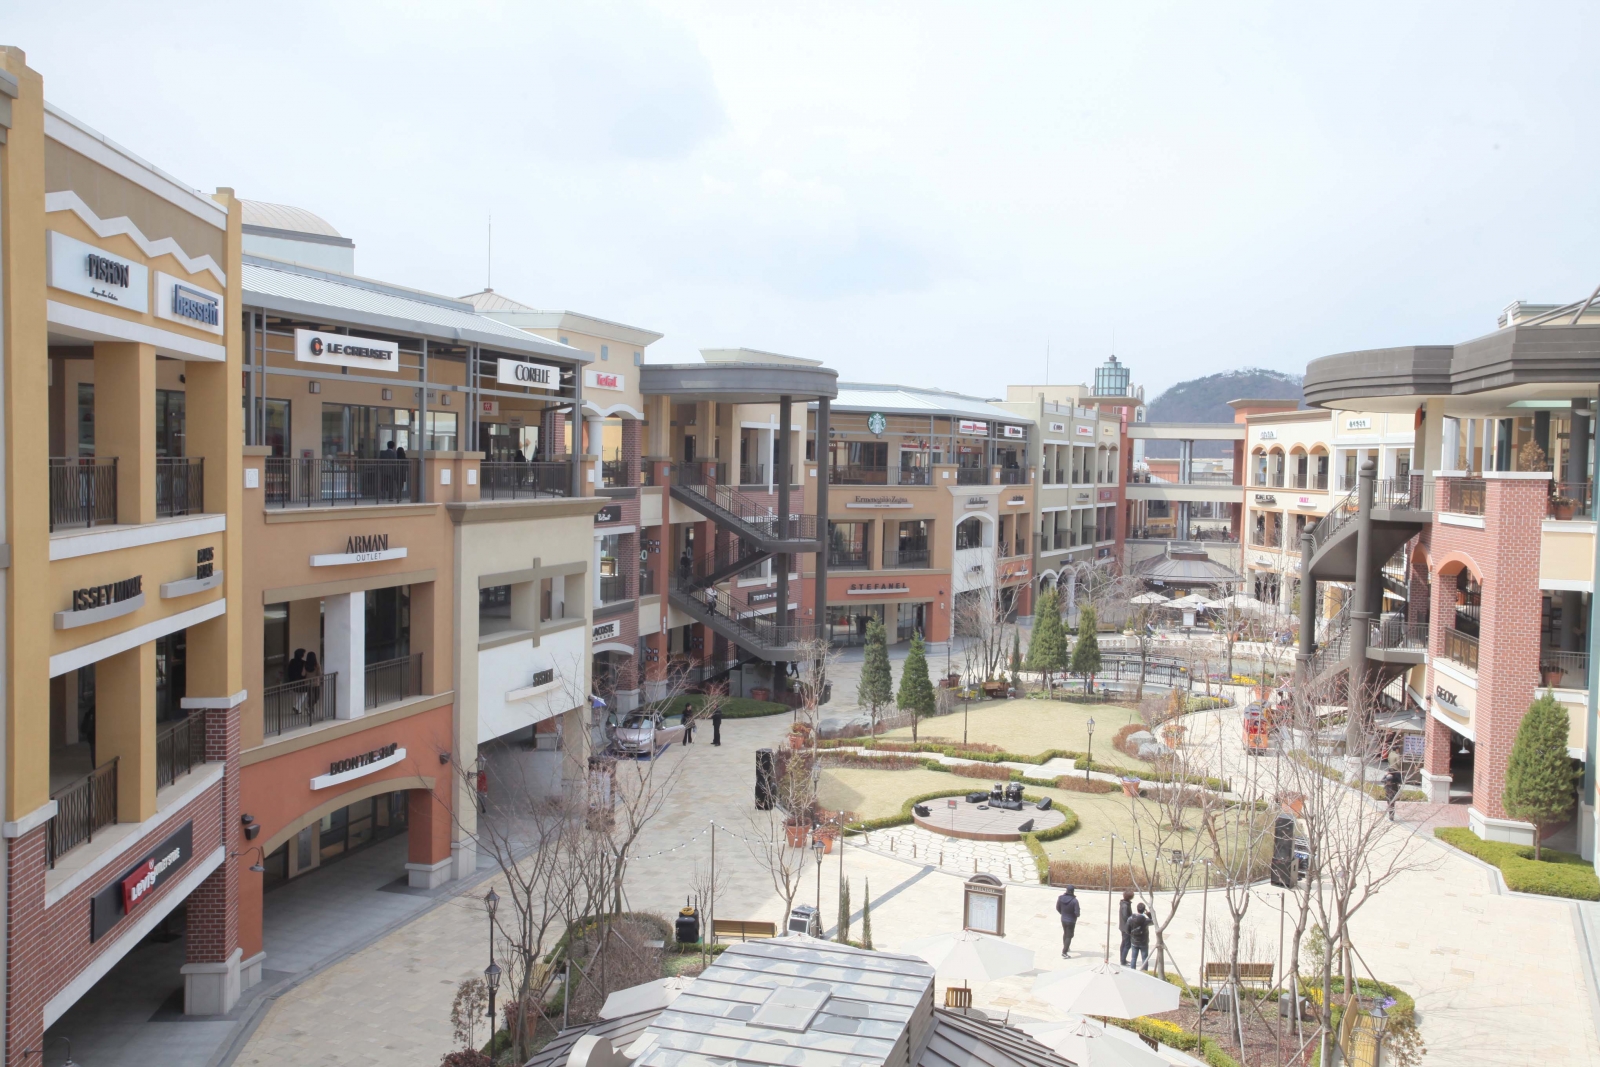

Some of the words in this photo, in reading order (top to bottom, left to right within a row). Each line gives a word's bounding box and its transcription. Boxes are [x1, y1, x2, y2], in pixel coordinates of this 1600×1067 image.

[327, 343, 342, 355] LE
[343, 345, 393, 361] CREUSET
[515, 364, 551, 385] CORELLE
[346, 534, 388, 554] ARMANI
[356, 552, 382, 562] OUTLET
[72, 583, 113, 612] ISSEY
[113, 574, 143, 603] MIYAKE
[851, 582, 907, 591] STEFANEL
[593, 623, 614, 637] ACOSTE
[1436, 685, 1457, 707] GEOX
